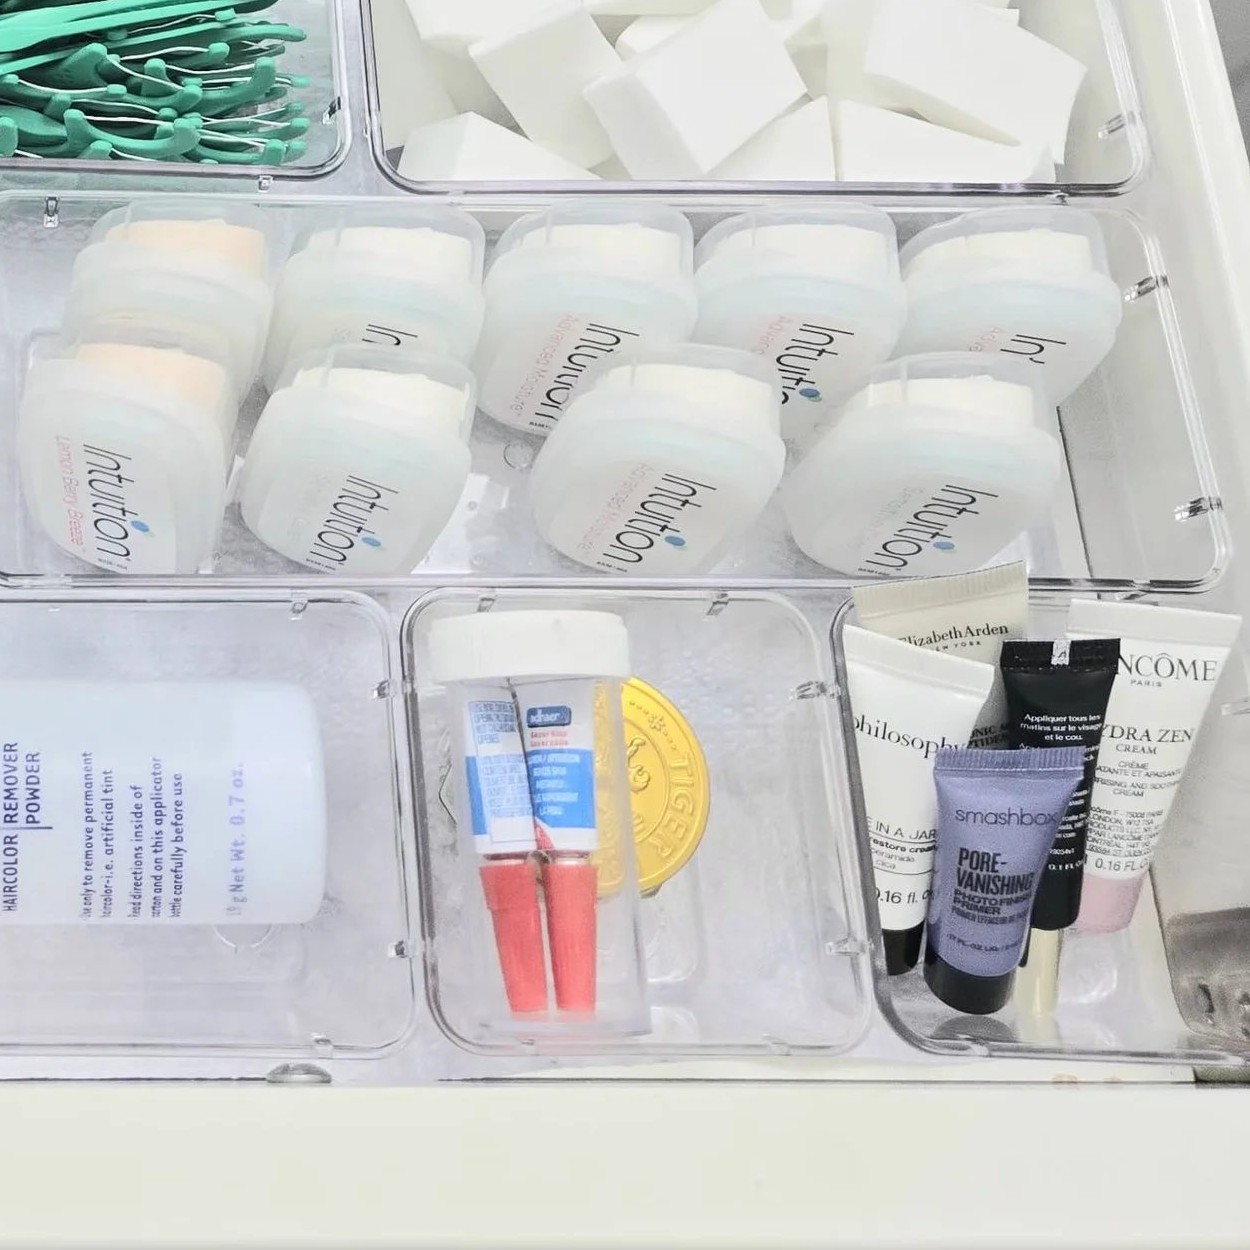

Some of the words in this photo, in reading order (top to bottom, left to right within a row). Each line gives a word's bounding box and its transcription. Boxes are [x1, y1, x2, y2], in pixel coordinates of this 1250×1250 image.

[83, 443, 139, 558] Intuition
[309, 474, 399, 563] Intuition
[602, 472, 718, 564] Intuition
[865, 484, 999, 569] Intuition
[963, 622, 1009, 638] Arden
[954, 640, 982, 648] YORK
[1129, 679, 1163, 688] PARIS
[1019, 722, 1052, 732] matins
[1023, 713, 1067, 725] Appliquer
[1068, 714, 1088, 723] tous
[1088, 713, 1102, 723] les
[1044, 733, 1054, 742] et
[1054, 733, 1064, 742] le
[1115, 743, 1158, 756] CREAM
[2, 741, 19, 824] REMOVER
[25, 750, 41, 825] POWDER
[82, 751, 98, 823] permanent
[101, 769, 113, 796] tint
[129, 784, 143, 799] of
[149, 756, 168, 827] applicator
[173, 772, 183, 796] use
[1112, 788, 1144, 798] CREAM
[228, 794, 245, 826] 0.7
[649, 749, 696, 861] TIGER
[954, 806, 1057, 827] smashbox
[100, 797, 114, 856] artificial
[129, 802, 143, 843] inside
[170, 799, 184, 844] before
[876, 820, 890, 835] IN
[893, 826, 905, 838] A
[908, 828, 937, 840] JAR
[84, 827, 94, 872] remove
[150, 828, 163, 855] this
[228, 833, 245, 862] Wt.
[2, 833, 19, 912] HAIRCOLOR
[129, 846, 143, 901] directions
[153, 857, 163, 873] on
[170, 846, 188, 897] carefully
[958, 846, 1008, 874] PORE-
[1095, 857, 1121, 871] 0.16
[82, 875, 93, 887] to
[150, 874, 163, 894] and
[228, 867, 245, 893] Net
[956, 866, 1035, 896] VANISHING
[952, 896, 1002, 916] PRIMER
[953, 888, 999, 907] PHOTO
